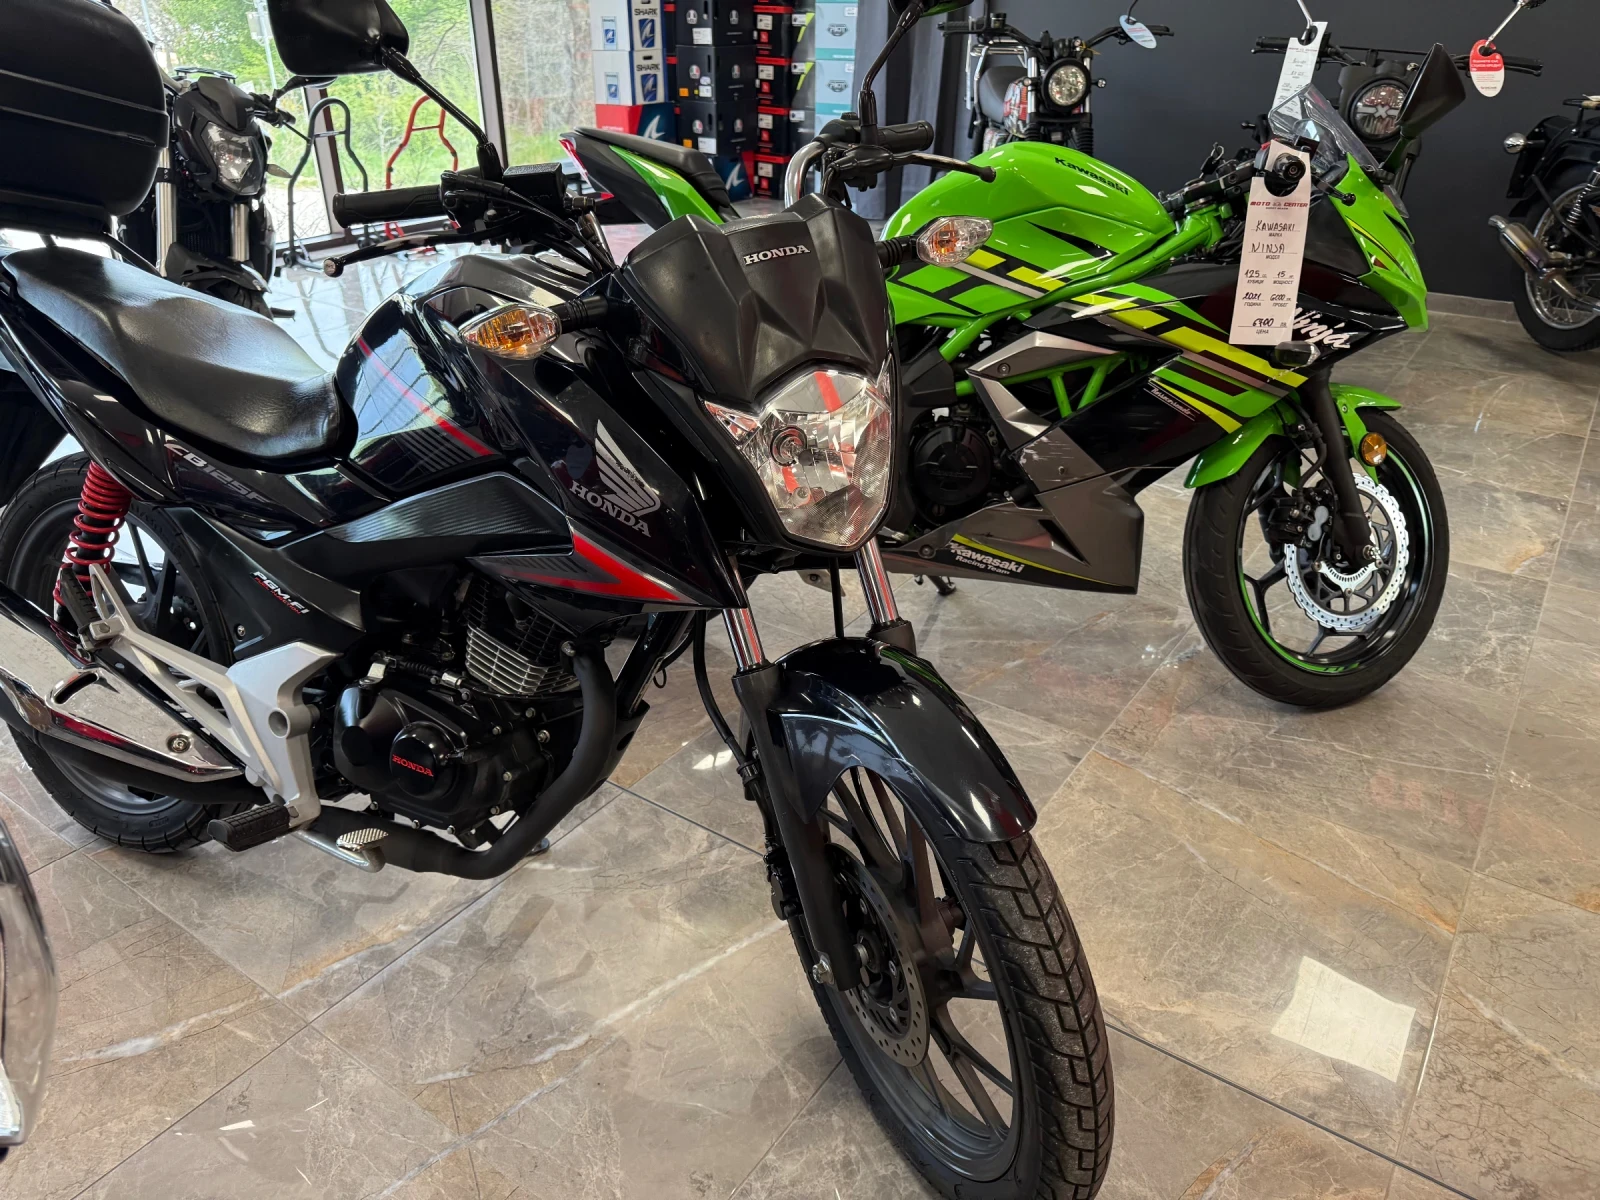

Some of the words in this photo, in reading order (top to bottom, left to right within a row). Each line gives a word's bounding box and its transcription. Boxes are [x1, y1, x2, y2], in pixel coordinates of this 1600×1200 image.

[634, 8, 658, 16] SHARK
[636, 64, 660, 72] SHARK
[1055, 157, 1129, 196] Kawasaki
[1255, 220, 1296, 232] KAWASAKI
[743, 244, 811, 266] HONDA
[1251, 242, 1285, 254] NINJA
[1244, 269, 1260, 279] 125
[1277, 270, 1287, 279] 15
[1241, 291, 1262, 301] 2021
[164, 443, 271, 503] CB125F
[569, 480, 652, 538] HONDA
[950, 541, 1026, 574] Kawasaki
[955, 555, 986, 569] Racing
[987, 564, 1011, 575] Team
[391, 754, 435, 778] HONDA
